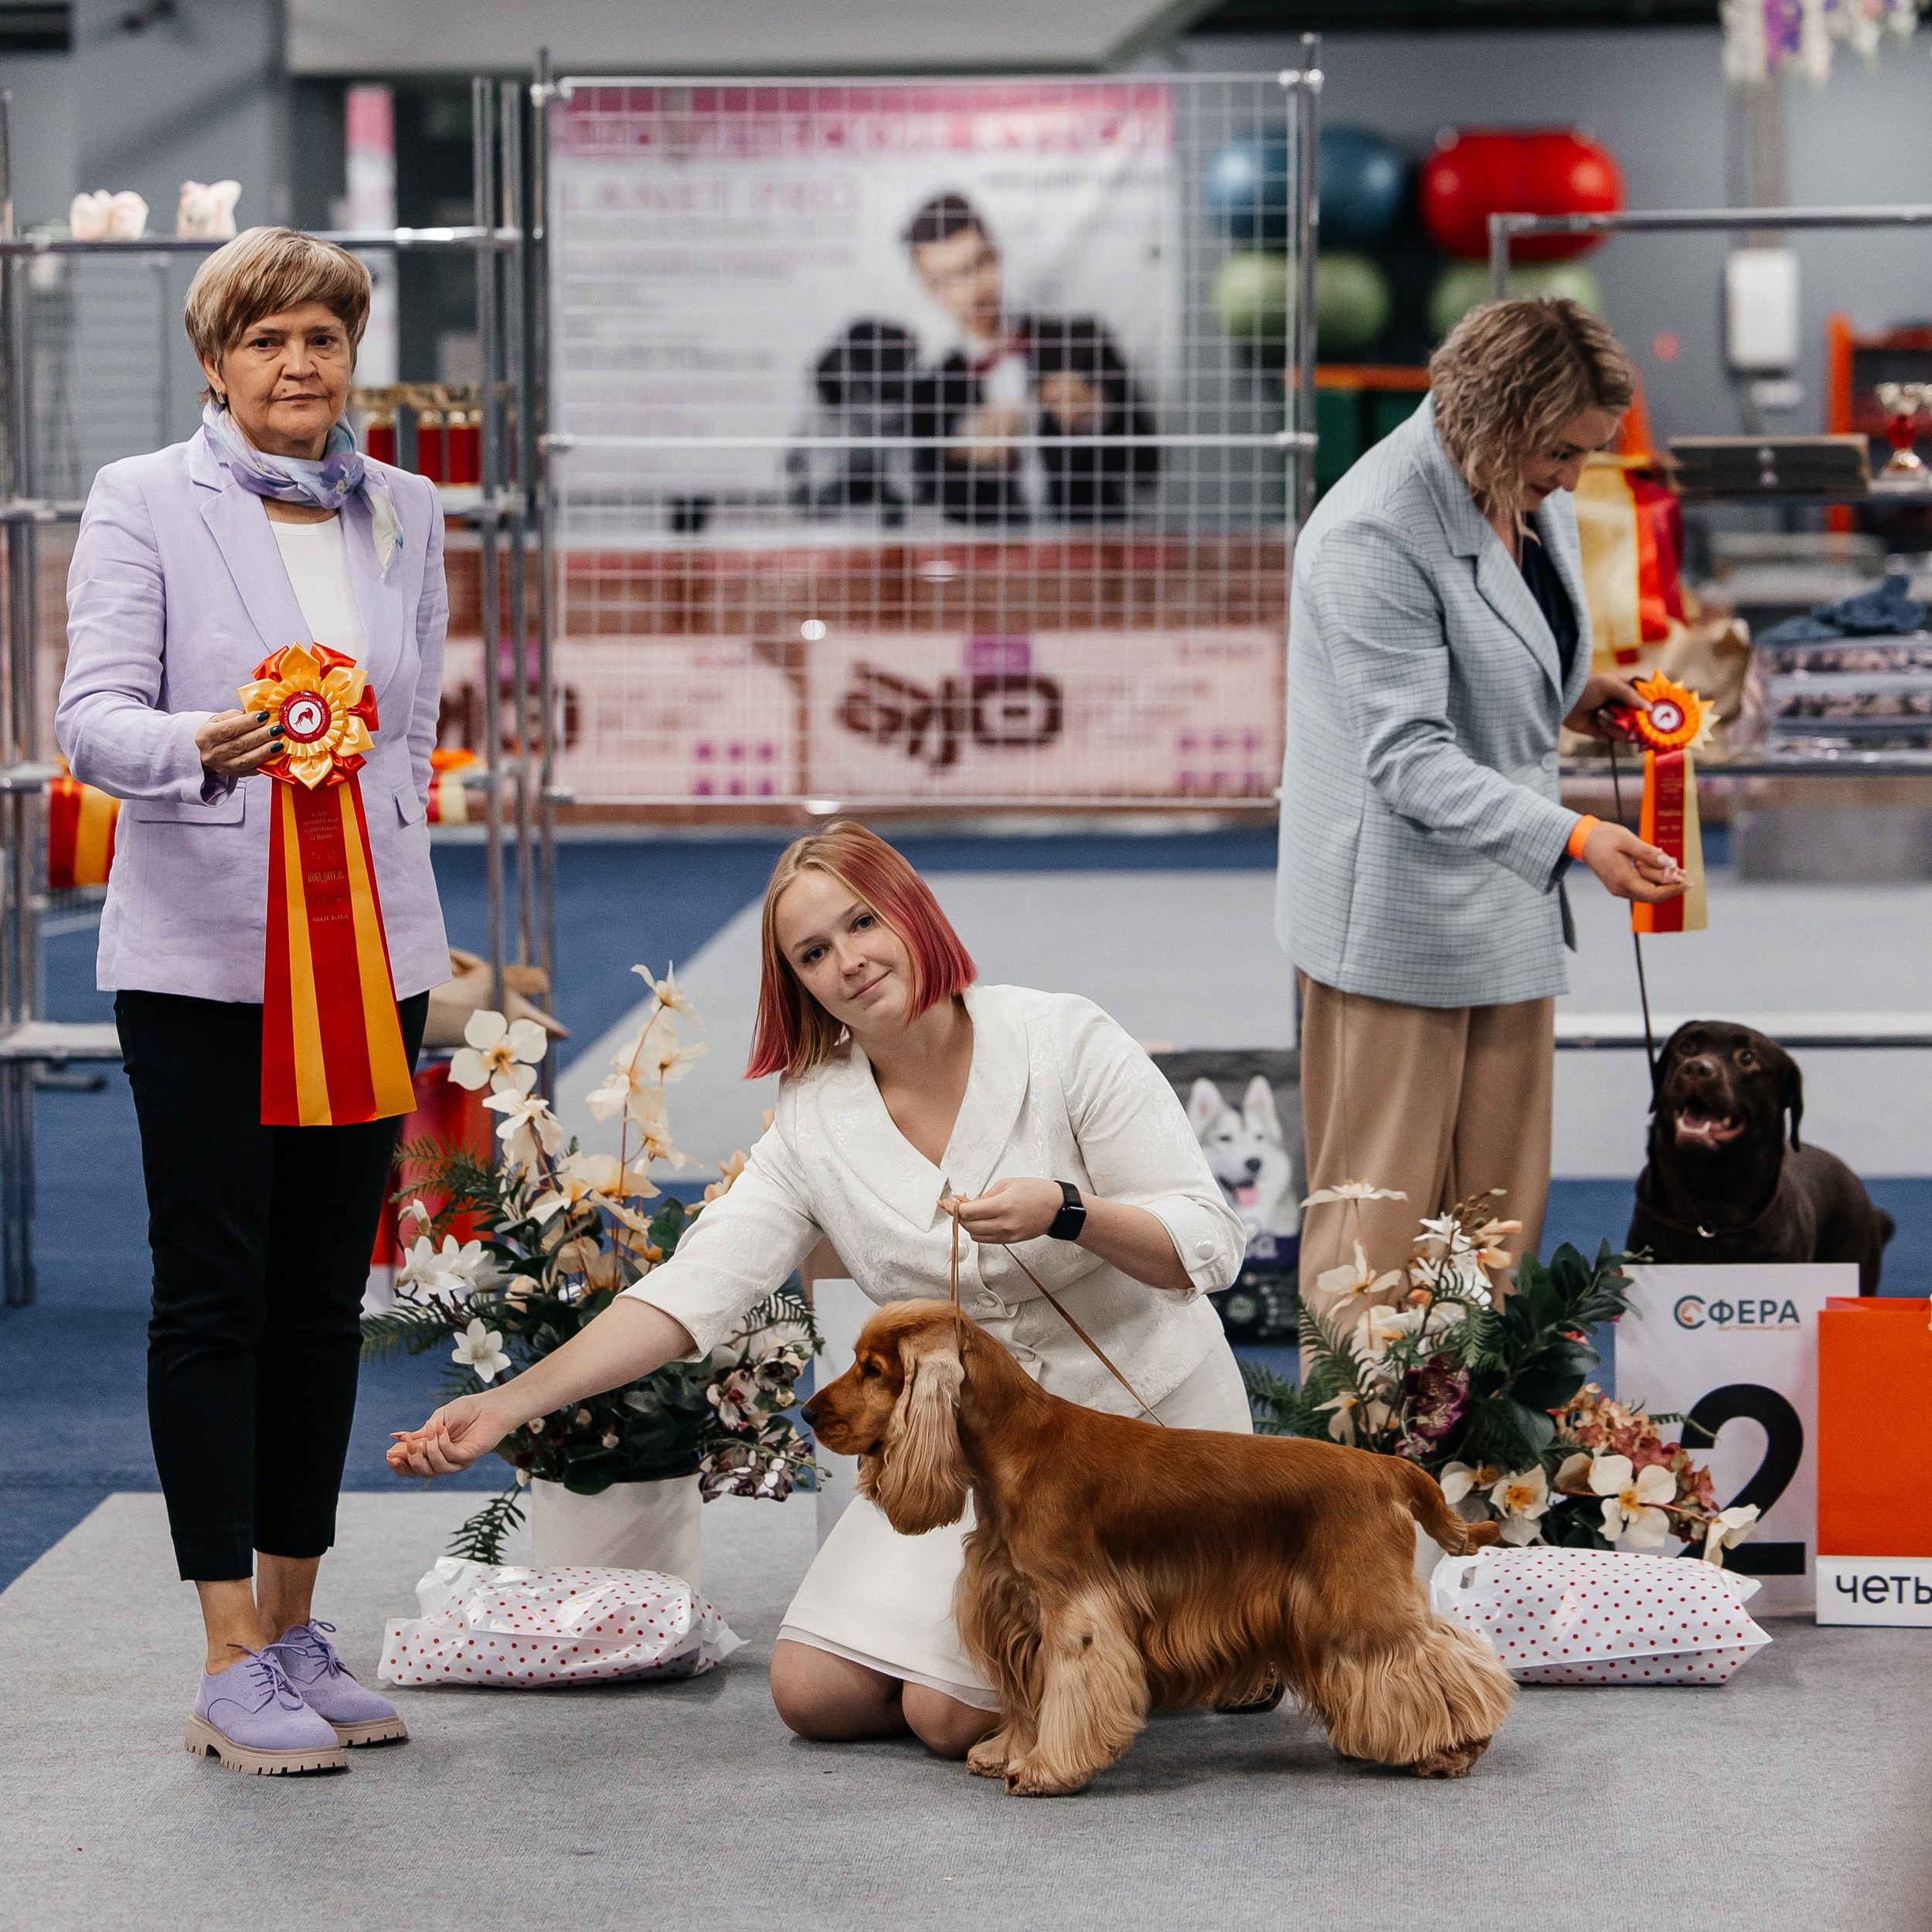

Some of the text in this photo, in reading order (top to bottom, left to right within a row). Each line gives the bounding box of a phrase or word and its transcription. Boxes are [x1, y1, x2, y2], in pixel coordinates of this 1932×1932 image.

[308, 870, 345, 884] ПОБЕДИТЕЛЬ
[1674, 1294, 1800, 1330] СФЕРА
[1677, 1383, 1806, 1576] 2
